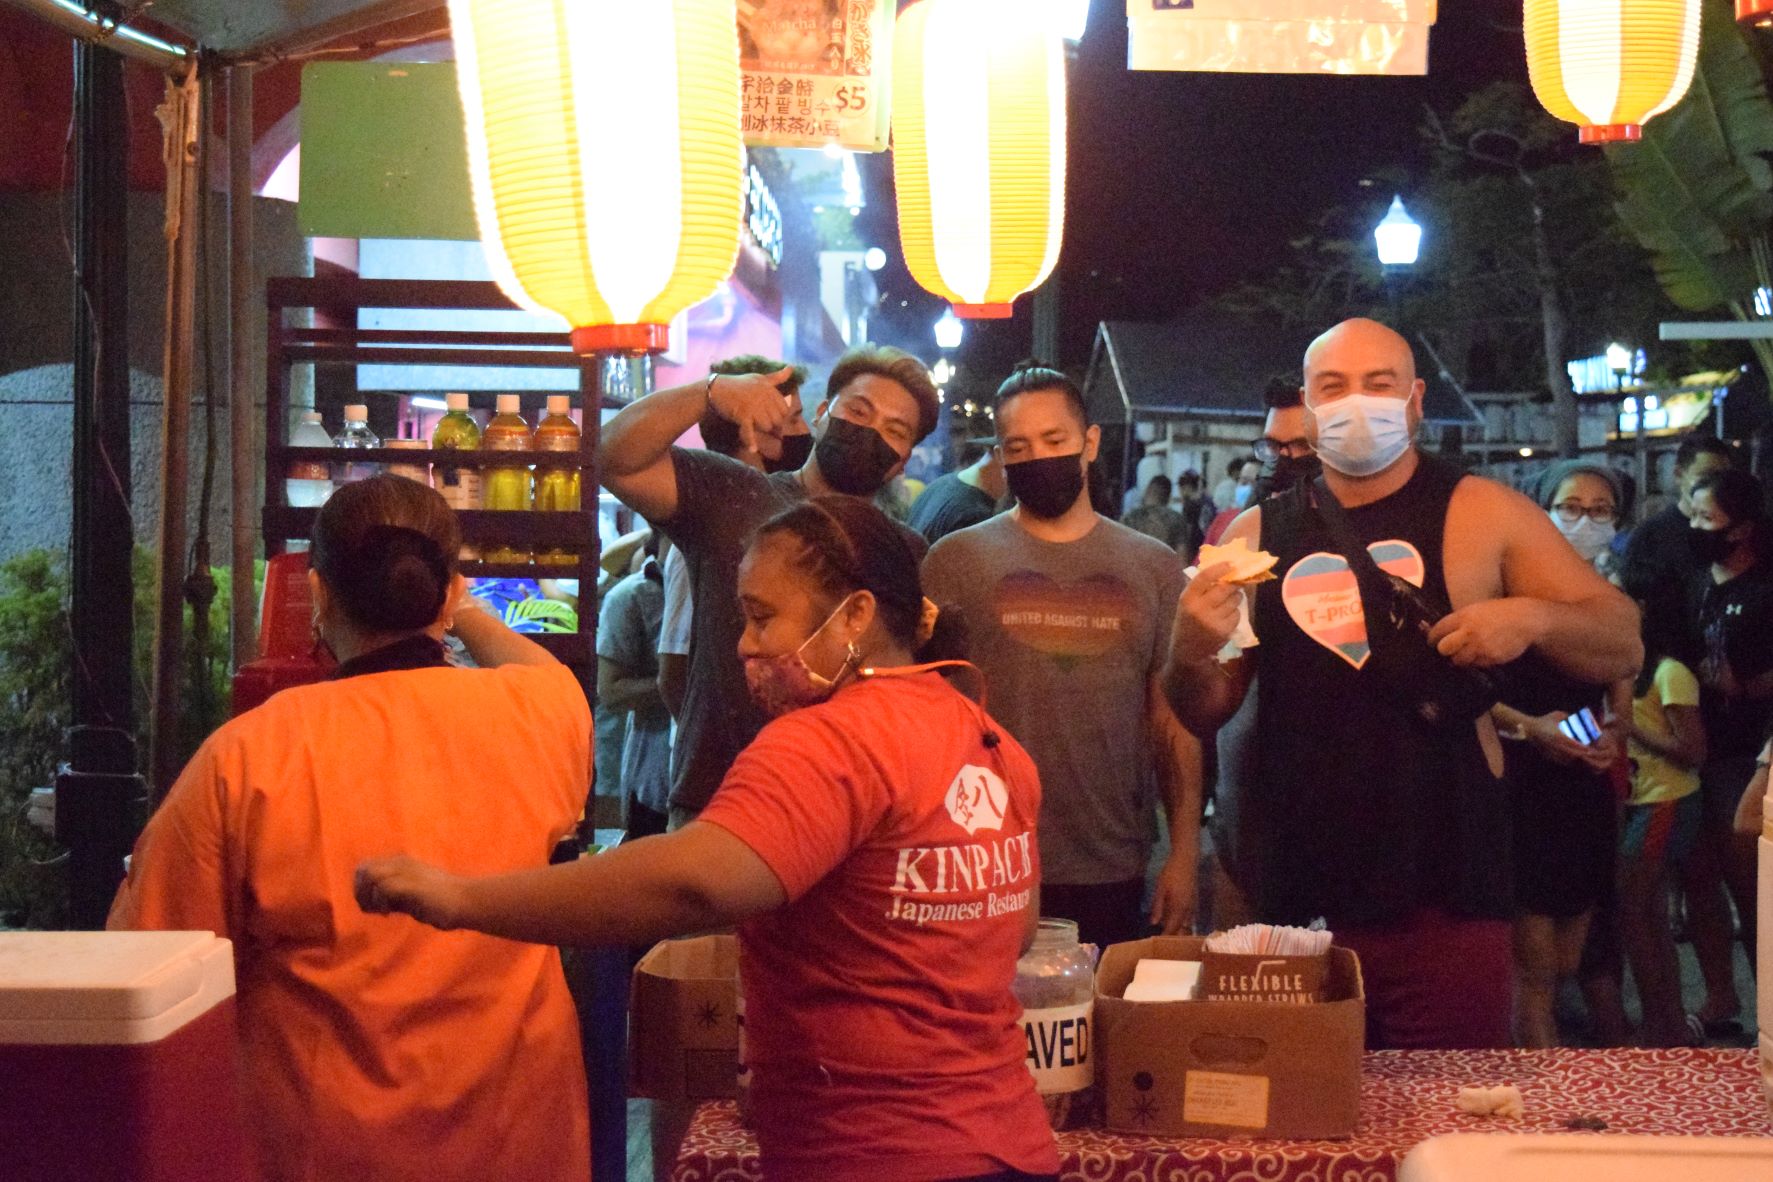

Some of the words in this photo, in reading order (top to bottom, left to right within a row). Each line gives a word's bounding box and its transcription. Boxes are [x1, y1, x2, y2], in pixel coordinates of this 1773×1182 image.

[835, 86, 867, 112] $5
[1002, 612, 1042, 625] UNITED
[1044, 614, 1088, 628] AGAINST
[1091, 617, 1121, 630] HATE
[885, 895, 983, 927] Japanese
[1219, 974, 1303, 991] FLEXIBLE
